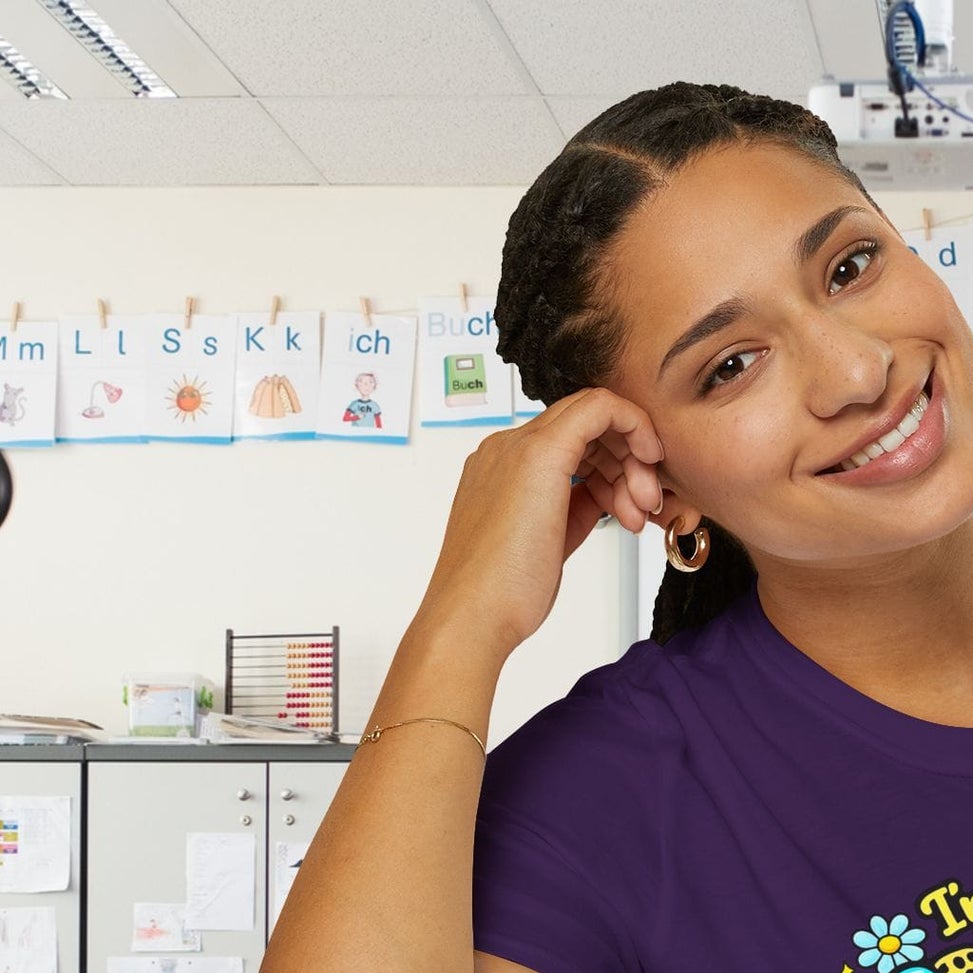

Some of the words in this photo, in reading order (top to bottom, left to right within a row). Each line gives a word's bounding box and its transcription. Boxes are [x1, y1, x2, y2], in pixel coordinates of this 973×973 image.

[938, 241, 957, 267] d
[19, 342, 45, 360] m
[75, 329, 92, 355] L
[162, 328, 181, 354] S
[202, 336, 218, 356] s
[245, 326, 265, 352] K
[286, 326, 301, 351] k
[348, 328, 391, 355] ich
[452, 379, 484, 391] Buch
